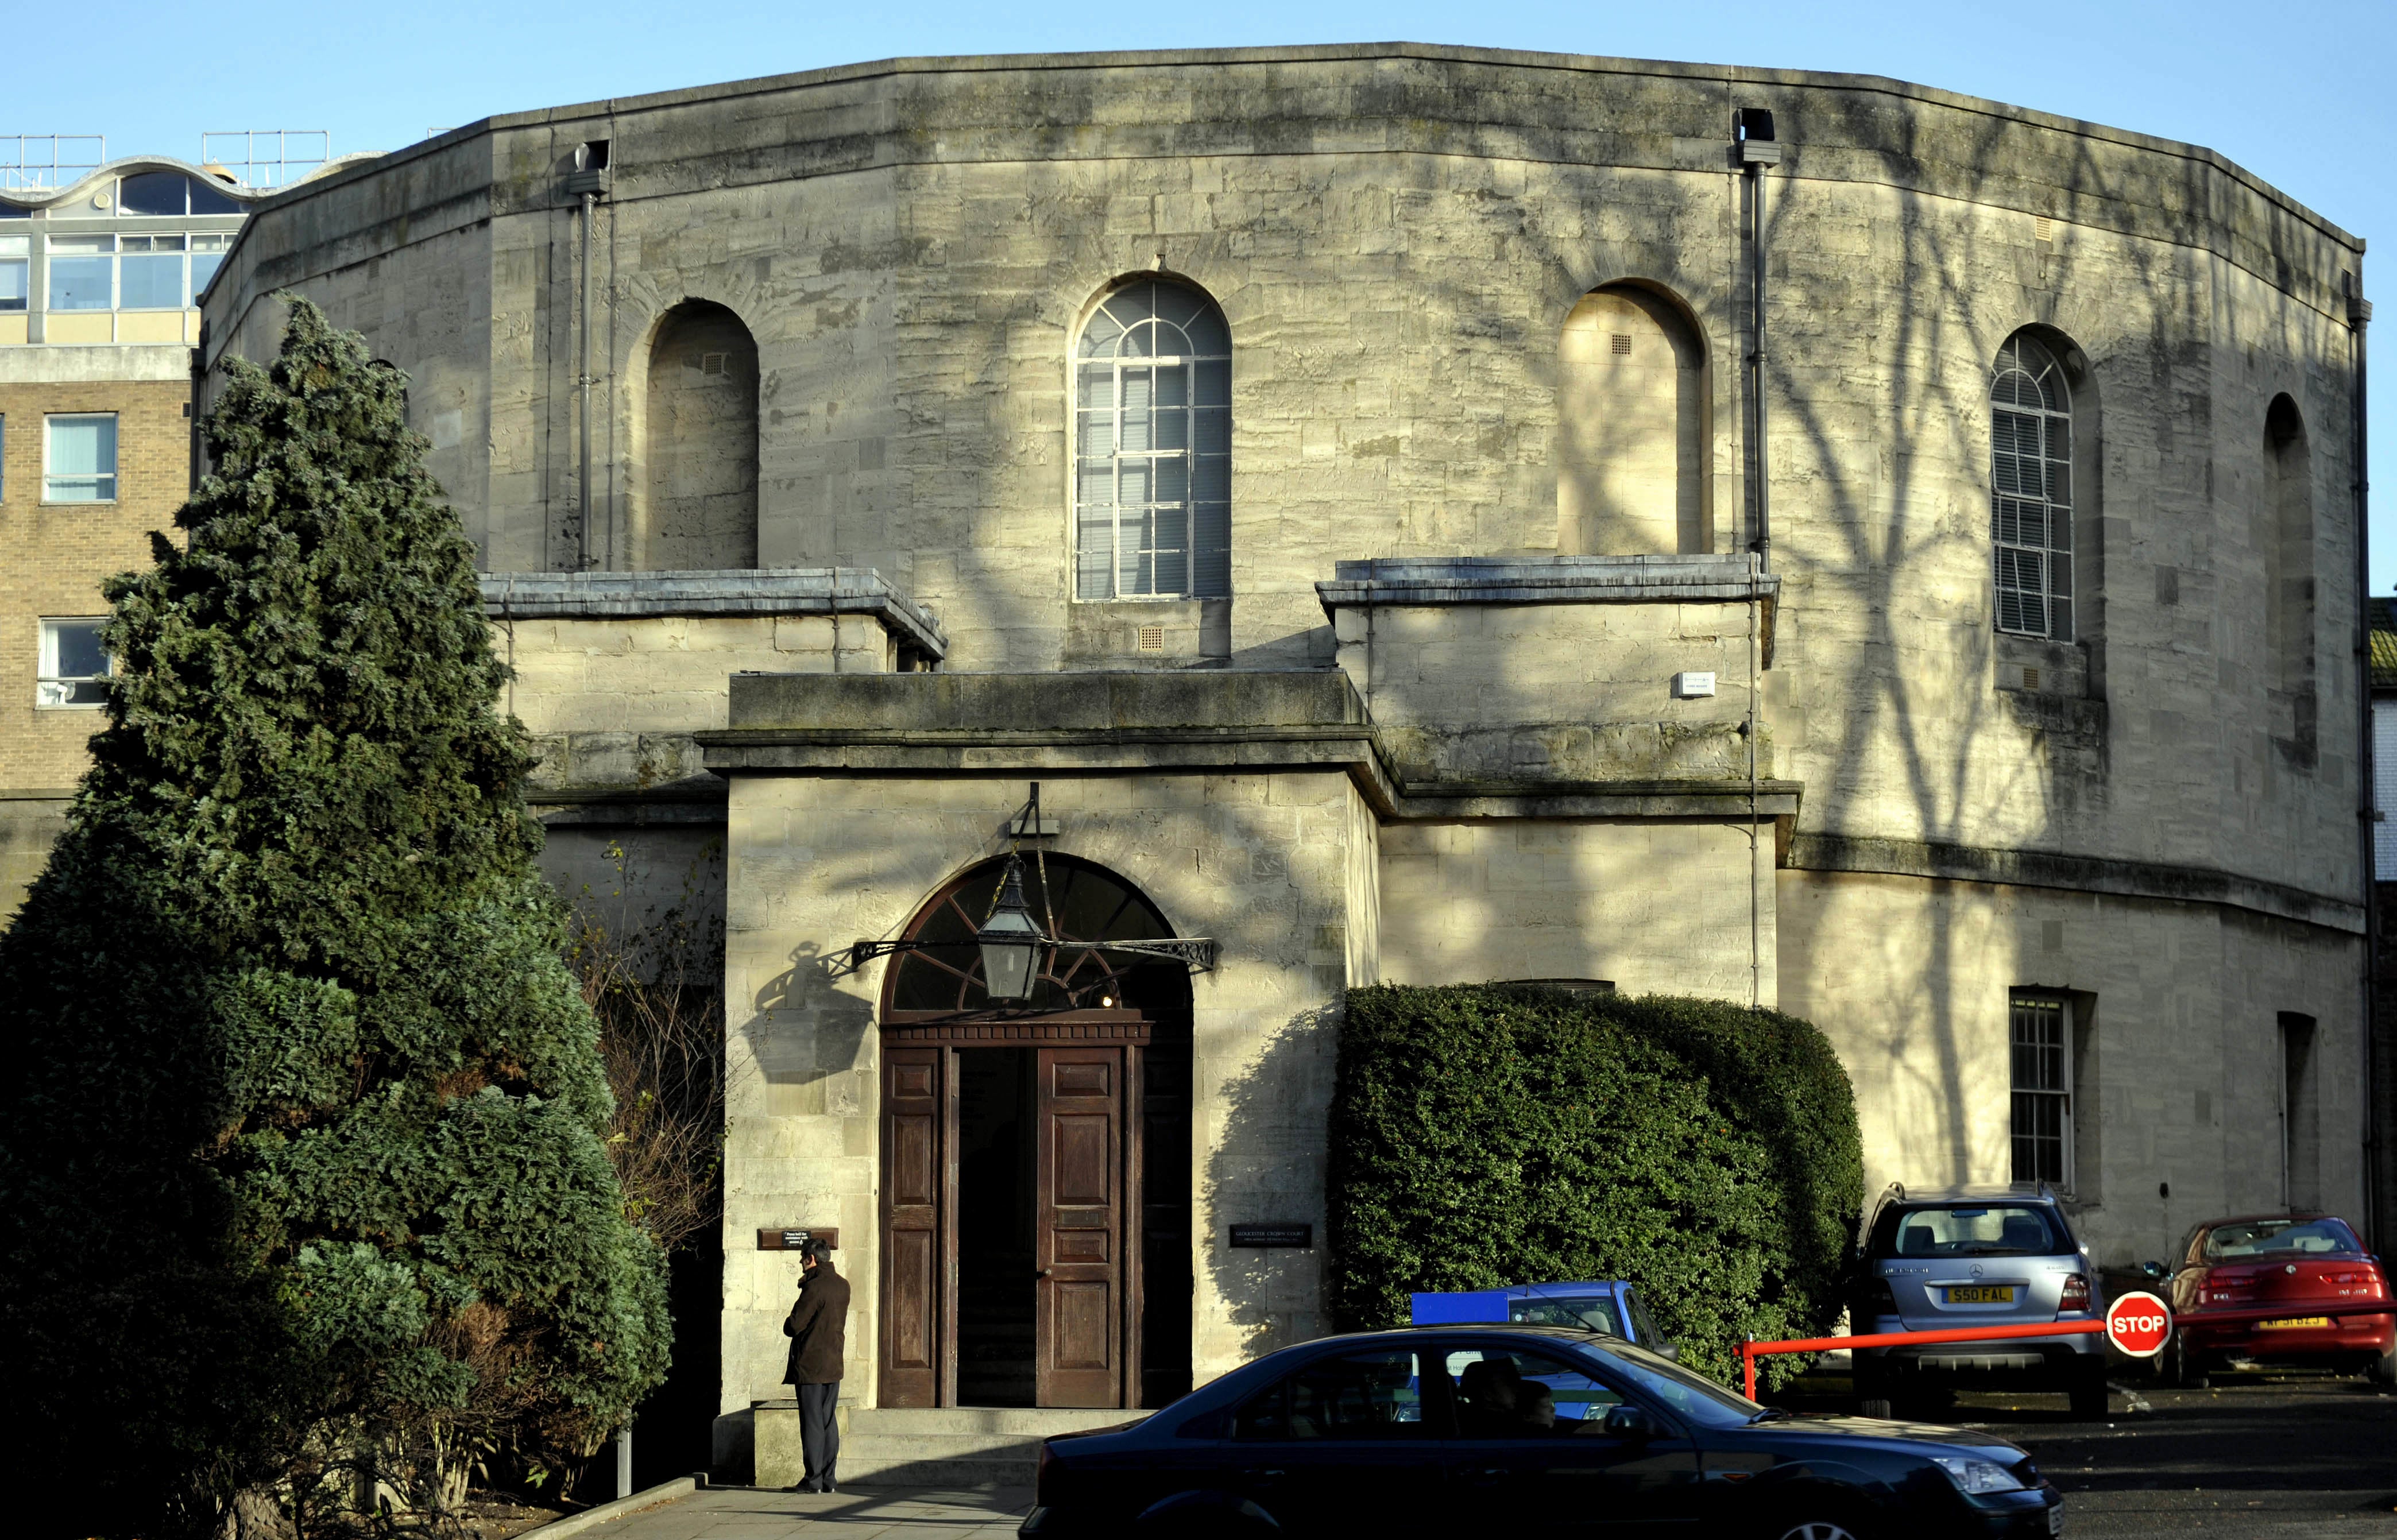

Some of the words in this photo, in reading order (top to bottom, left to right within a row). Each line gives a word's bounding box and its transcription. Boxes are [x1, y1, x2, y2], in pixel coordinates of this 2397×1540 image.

[1954, 1289, 1979, 1301] S50
[1982, 1289, 2006, 1301] FAL
[2114, 1315, 2165, 1334] STOP
